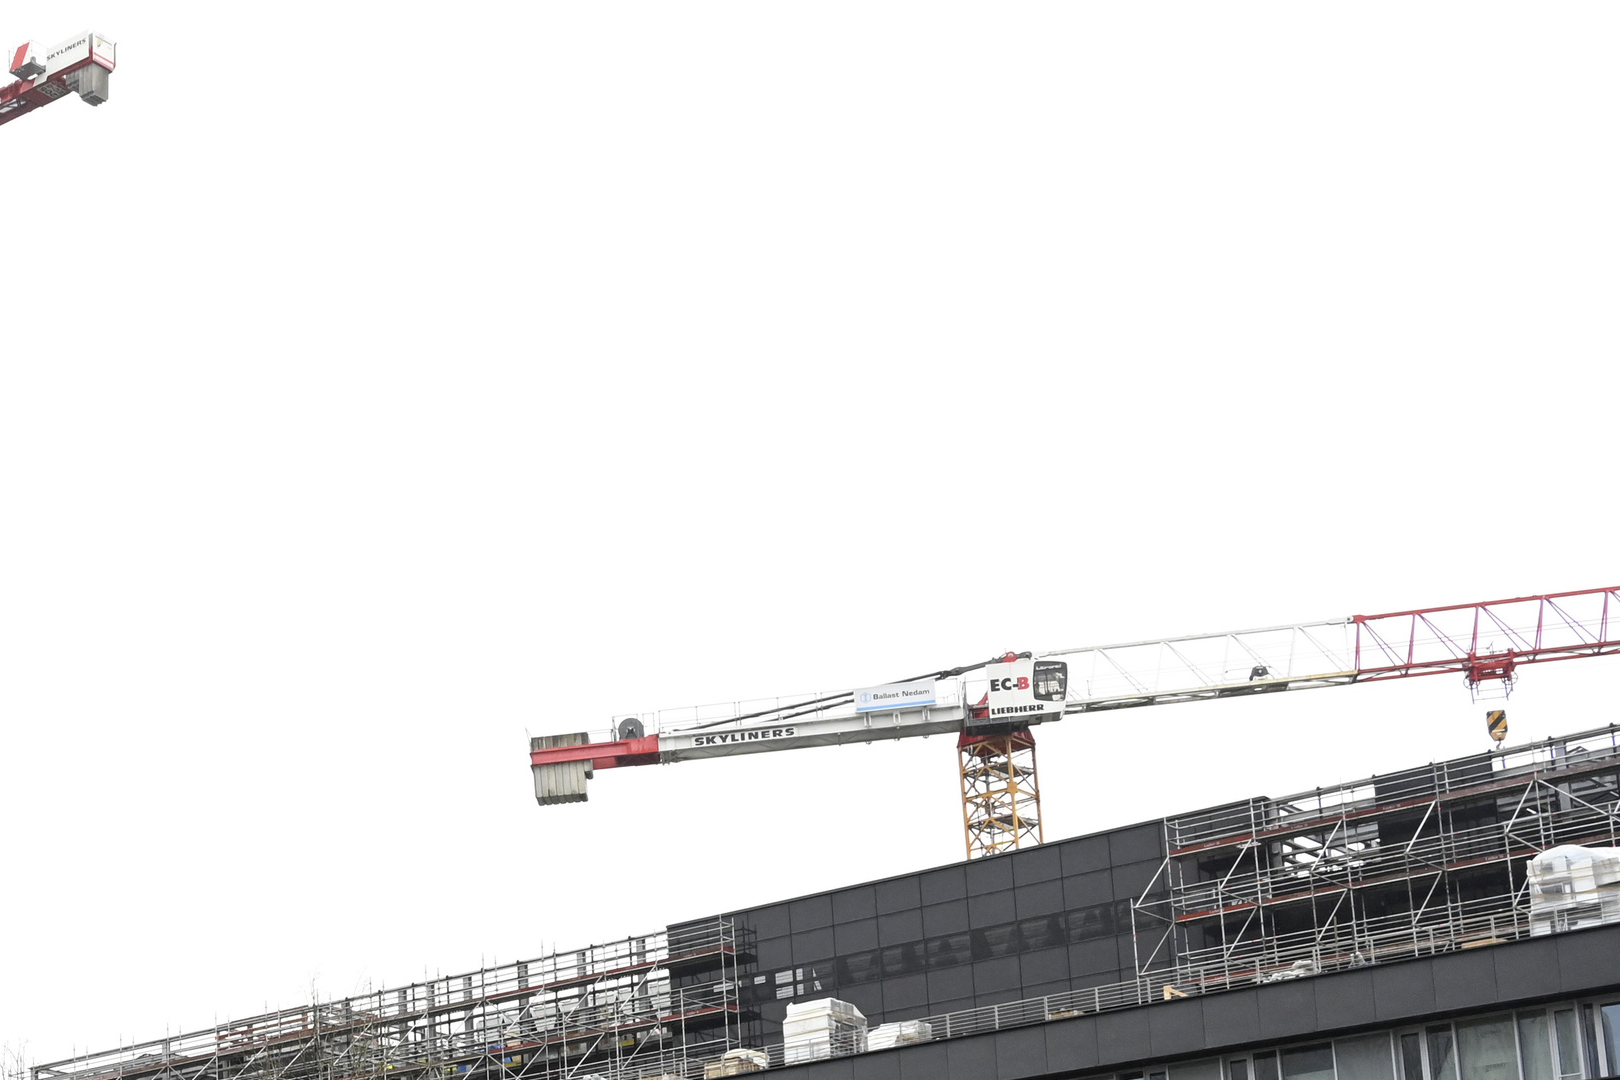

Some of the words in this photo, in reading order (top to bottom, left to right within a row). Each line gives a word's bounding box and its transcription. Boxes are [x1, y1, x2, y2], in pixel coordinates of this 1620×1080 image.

[47, 38, 87, 61] SKYLINERS
[990, 677, 1030, 692] EC-B
[873, 692, 899, 701] Ballast
[902, 689, 930, 698] Nedam
[991, 703, 1044, 716] LIEBHERR
[694, 727, 795, 746] SKYLINERS
